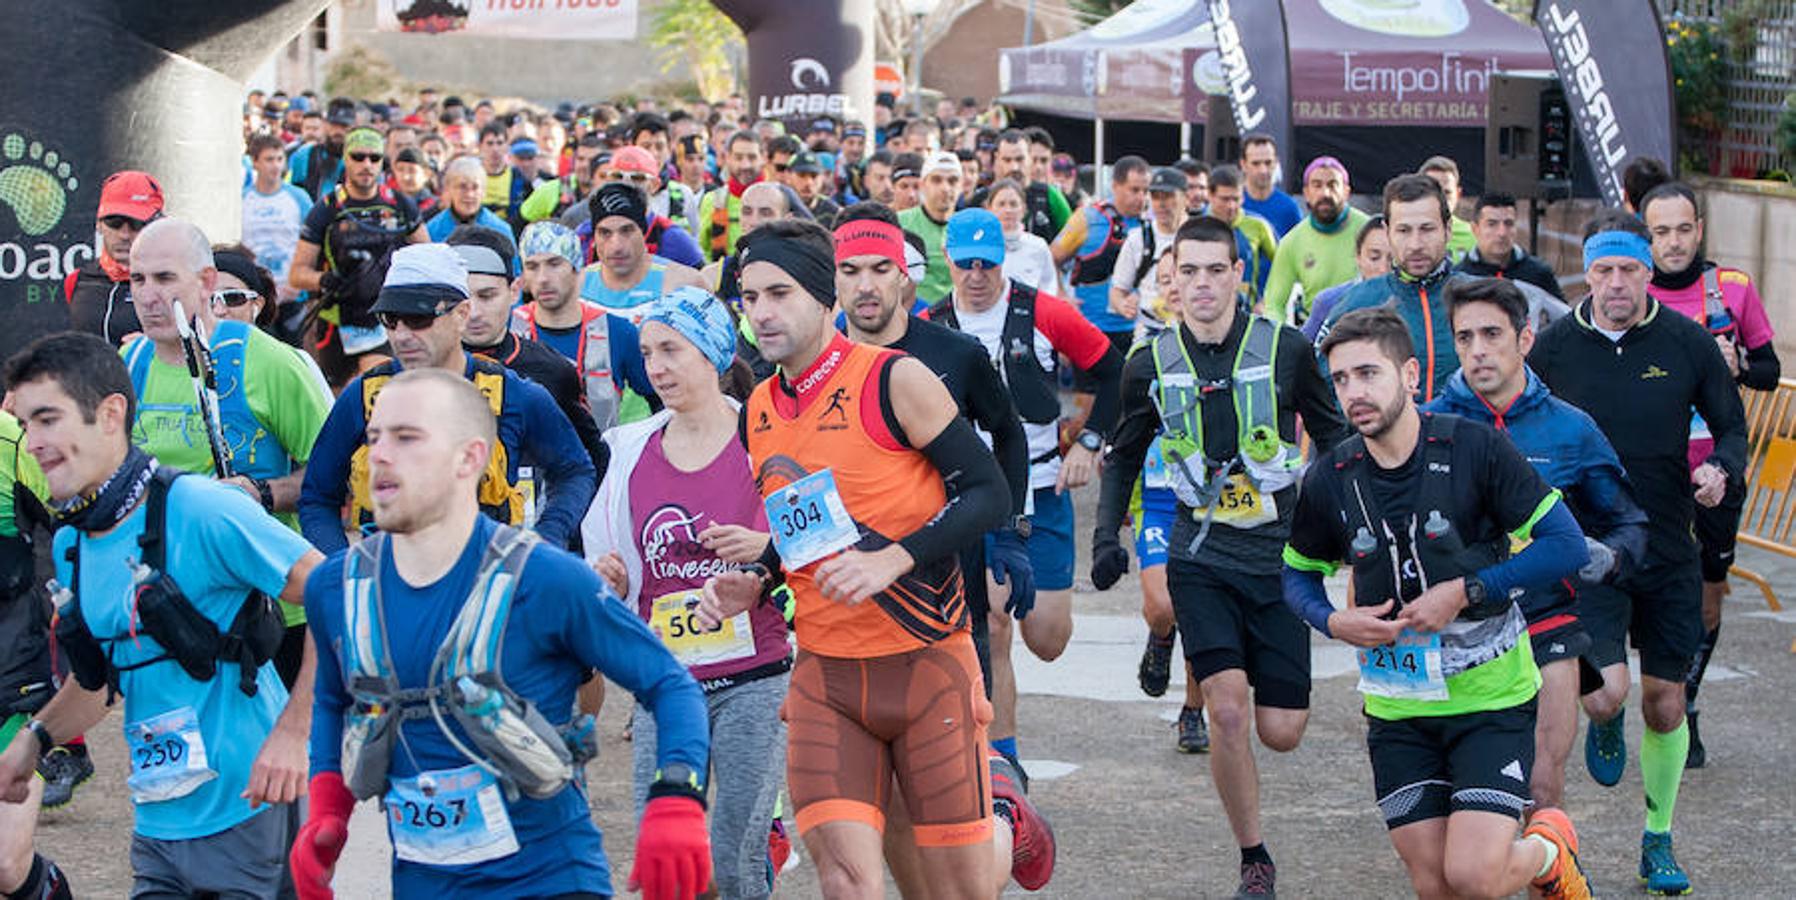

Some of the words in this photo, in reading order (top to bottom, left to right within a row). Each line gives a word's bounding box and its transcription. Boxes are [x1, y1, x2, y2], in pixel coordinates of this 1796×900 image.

[758, 94, 859, 118] LURBEL
[1351, 102, 1361, 118] Y
[1367, 99, 1477, 119] SECRETARÍA
[27, 285, 59, 303] BY
[780, 501, 822, 538] 304
[1372, 648, 1418, 674] 214
[137, 739, 183, 769] 250
[404, 798, 466, 828] 267
